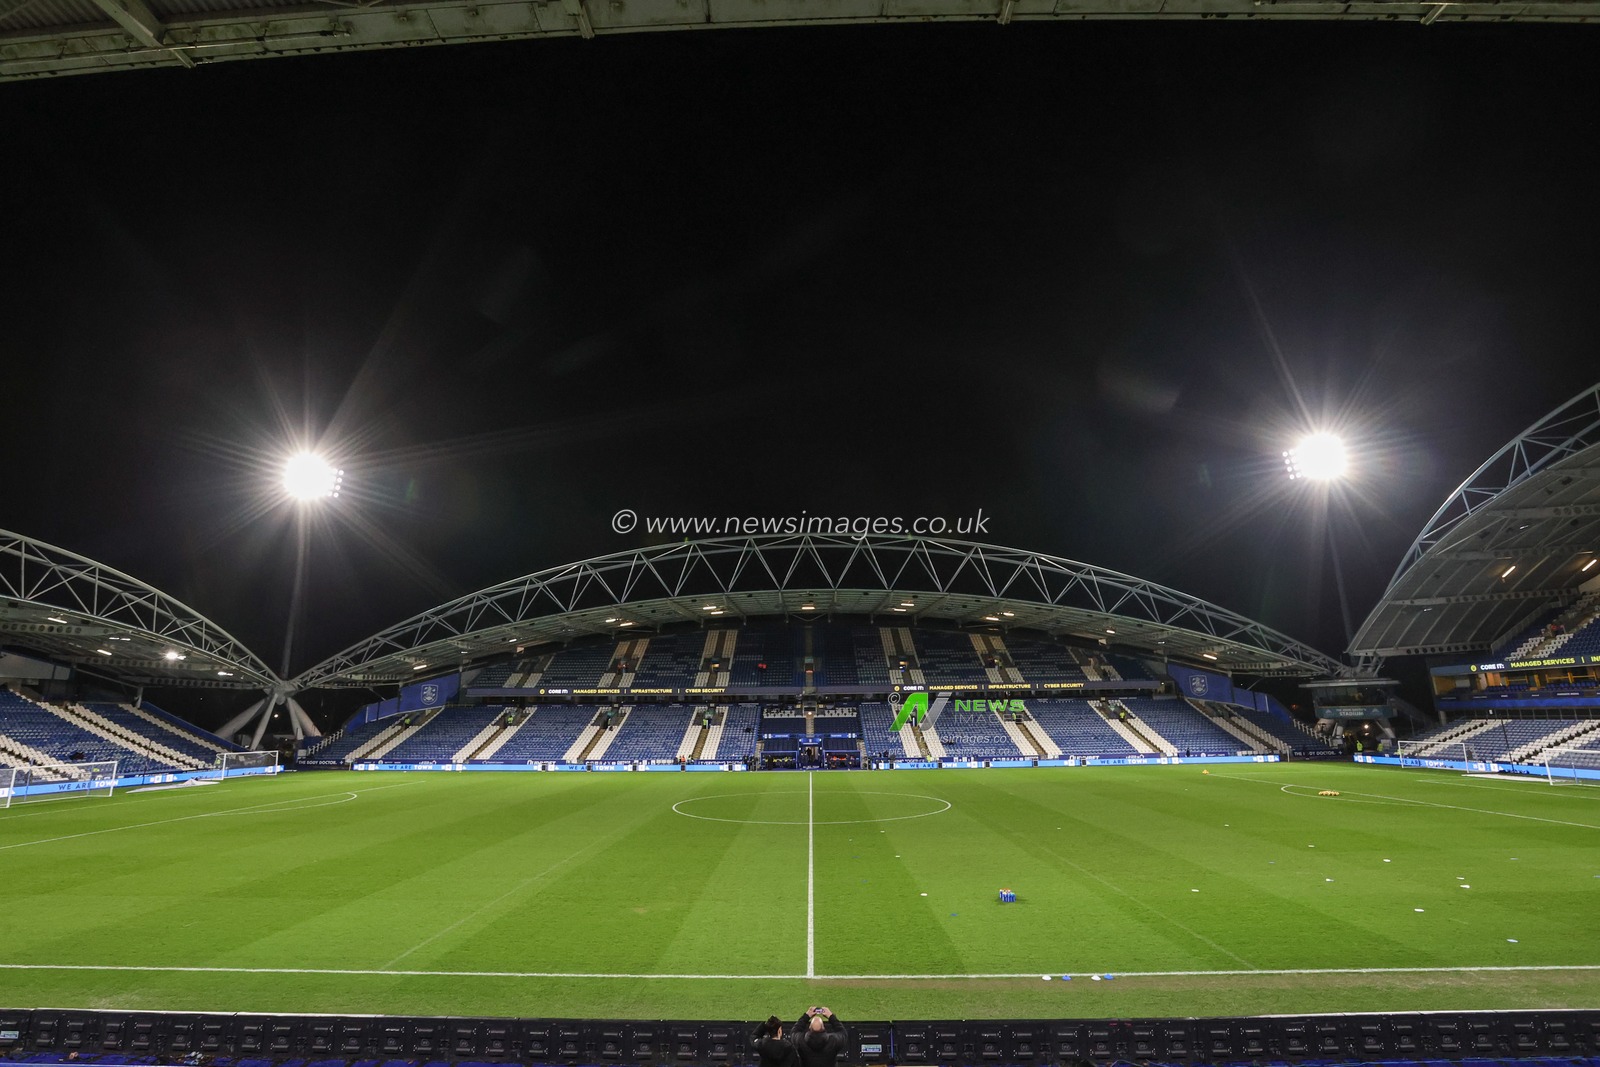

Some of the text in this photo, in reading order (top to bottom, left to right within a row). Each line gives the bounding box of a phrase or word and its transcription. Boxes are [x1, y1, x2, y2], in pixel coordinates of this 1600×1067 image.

[1510, 660, 1542, 668] MANAGED
[1542, 657, 1576, 666] SERVICES
[58, 783, 72, 791] WE
[94, 779, 119, 788] TOWN
